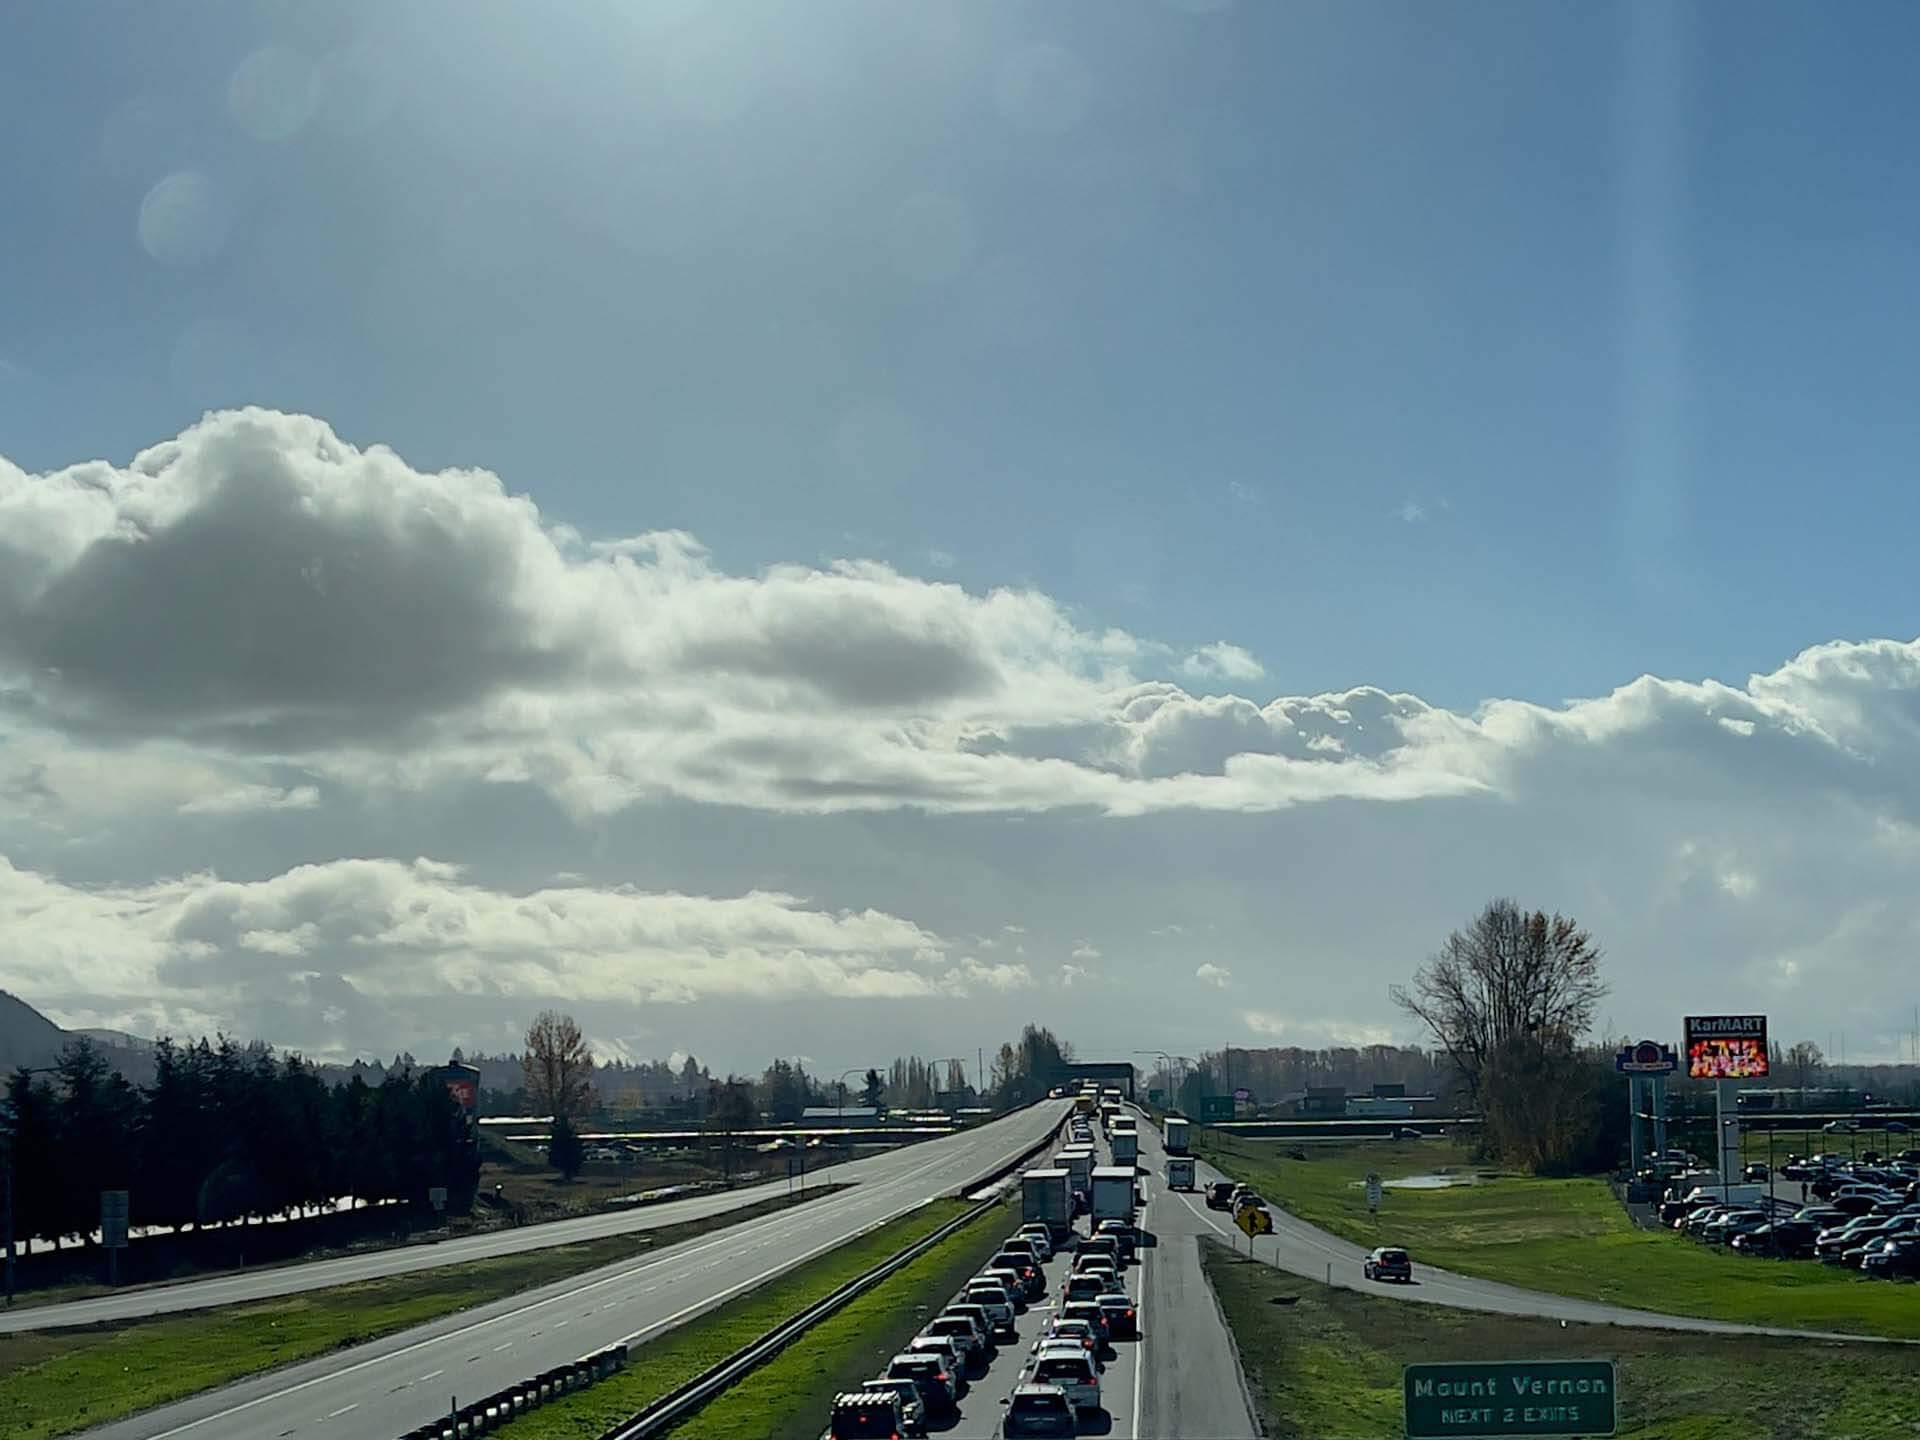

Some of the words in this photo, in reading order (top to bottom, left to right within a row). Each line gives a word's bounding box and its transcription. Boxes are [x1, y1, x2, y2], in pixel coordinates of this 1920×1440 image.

[1691, 1017, 1762, 1031] KarMART
[1415, 1377, 1496, 1398] Mount
[1512, 1376, 1607, 1396] Vernon
[1441, 1408, 1491, 1424] NEXT
[1503, 1408, 1516, 1423] 2
[1523, 1406, 1581, 1423] EXITS
